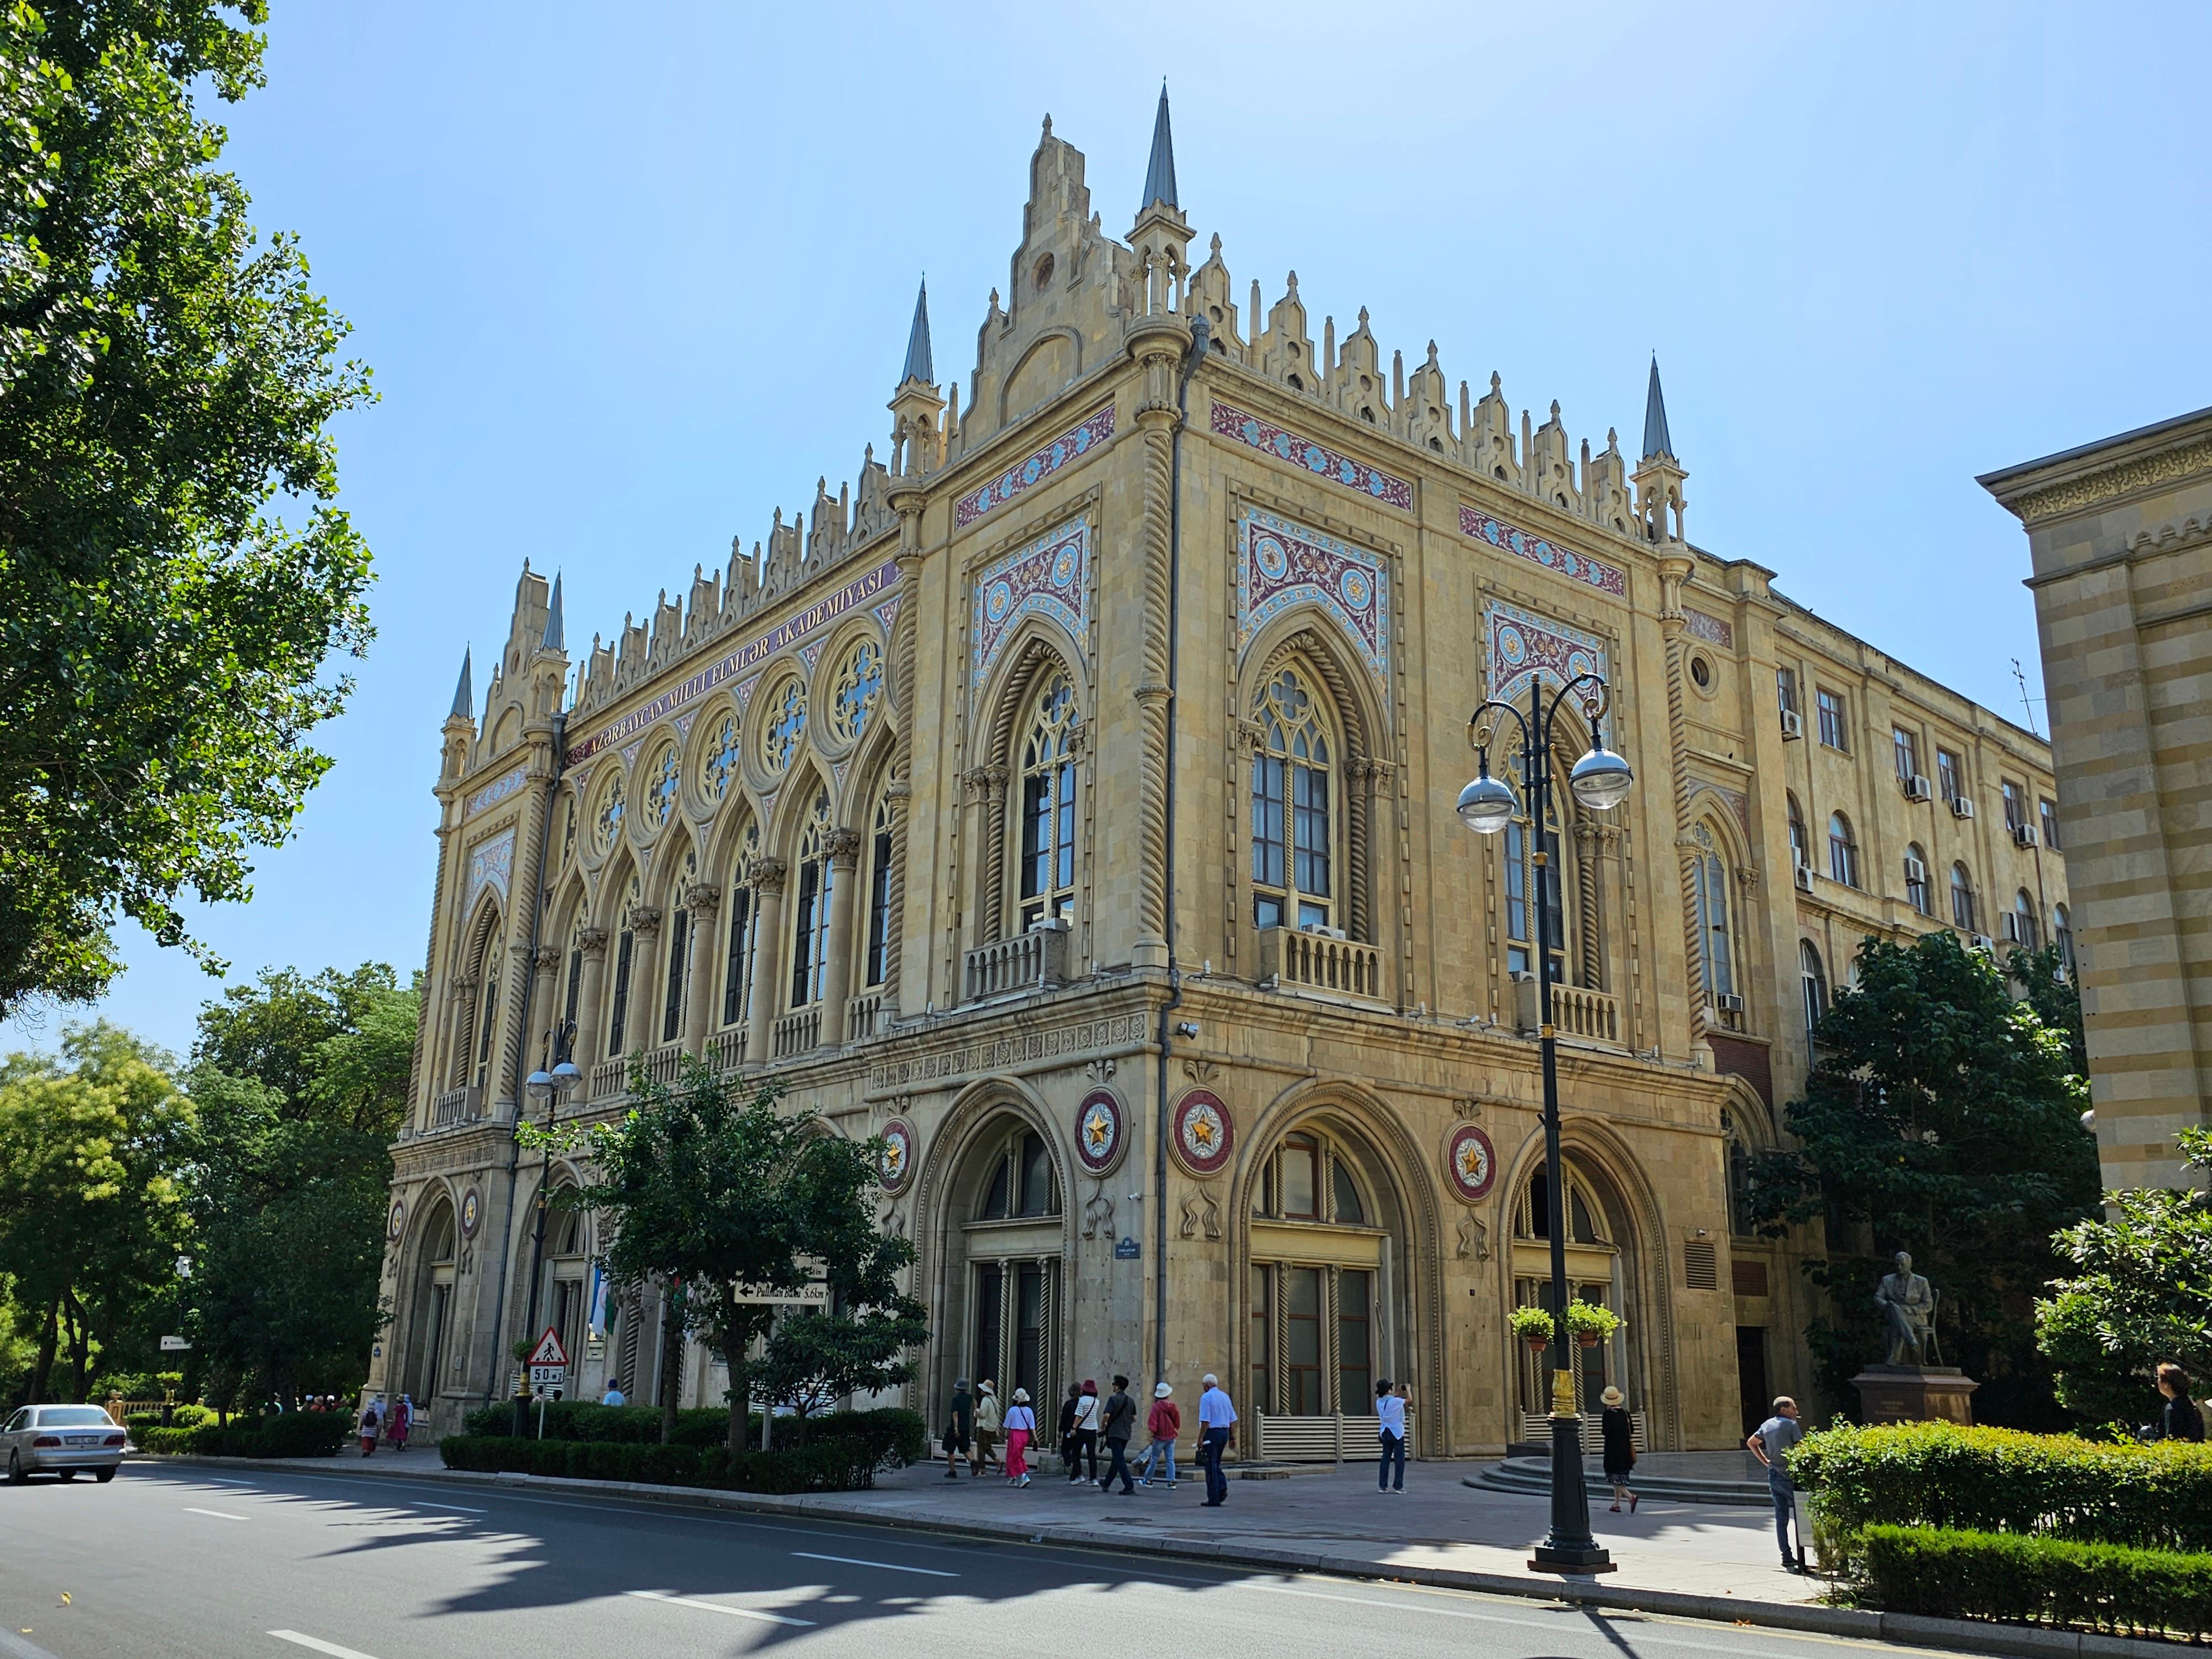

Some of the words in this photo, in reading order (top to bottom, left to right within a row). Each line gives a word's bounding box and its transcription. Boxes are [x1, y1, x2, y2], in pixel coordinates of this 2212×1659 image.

[590, 698, 664, 755] AZƏRBAYCAN
[668, 670, 707, 710] MİLLİ
[712, 638, 769, 685] ELMLƏR
[775, 568, 884, 649] AKADEMİYASI
[535, 1369, 549, 1380] 50
